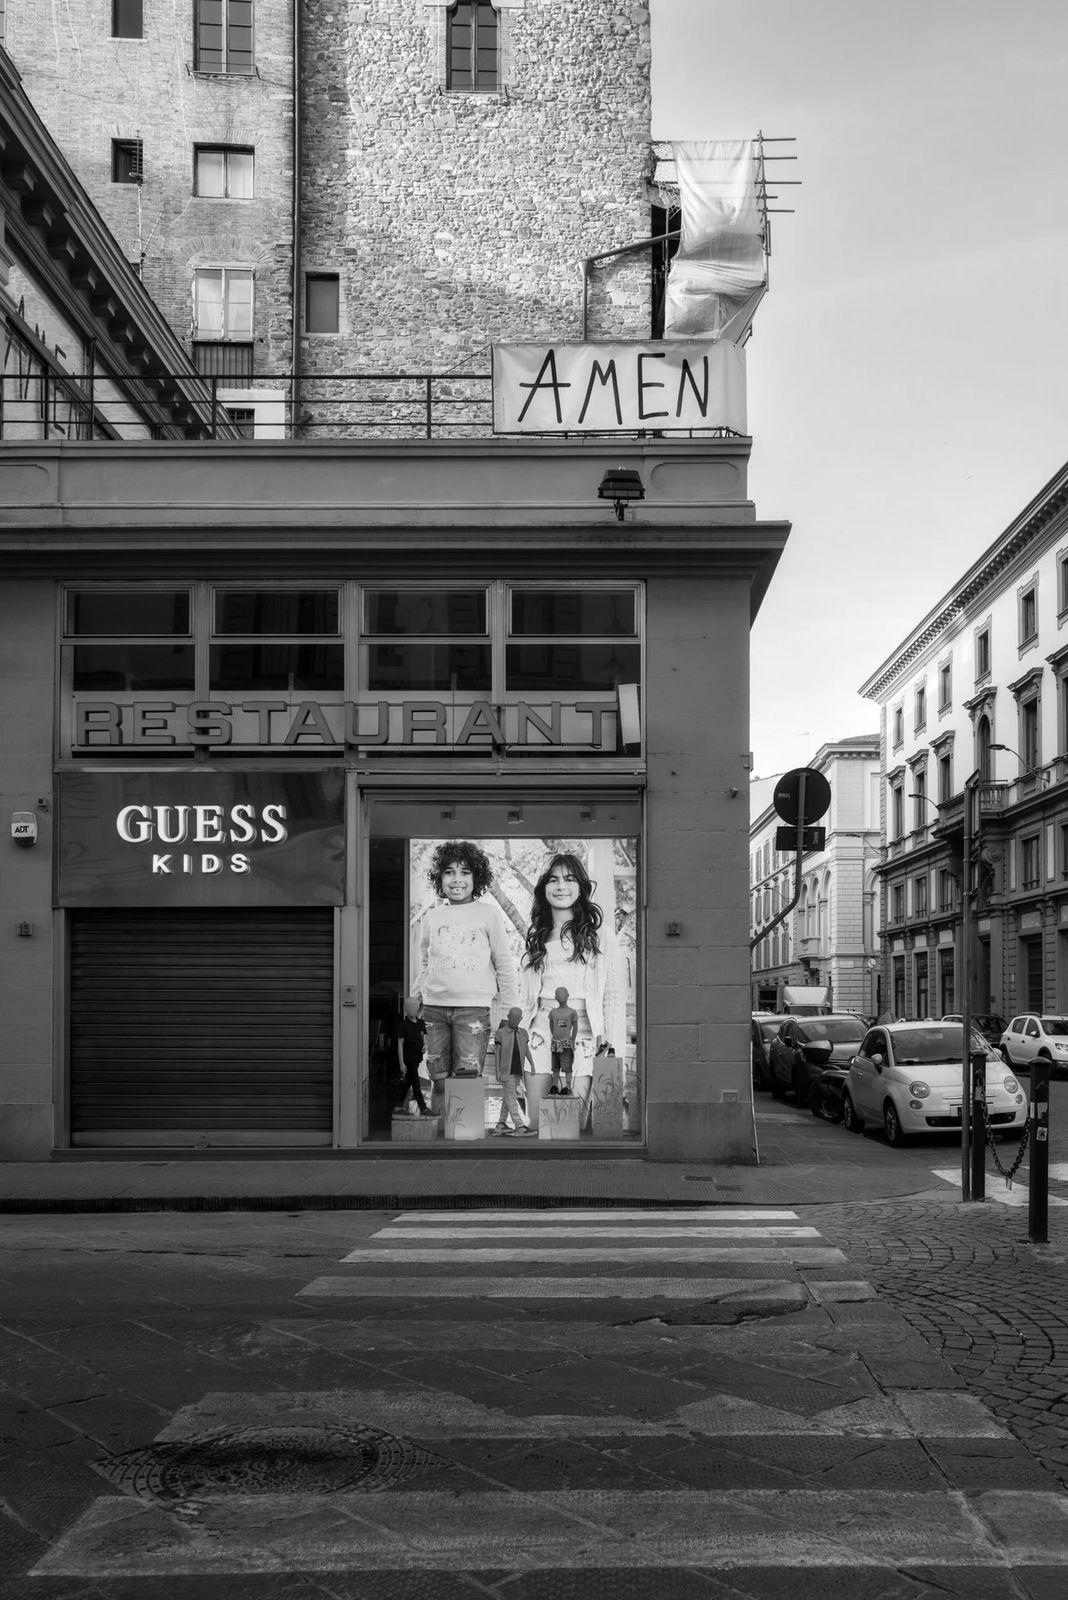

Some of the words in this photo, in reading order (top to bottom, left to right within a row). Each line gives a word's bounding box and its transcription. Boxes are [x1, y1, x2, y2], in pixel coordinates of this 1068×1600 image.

[517, 348, 709, 426] AMEN
[76, 700, 618, 746] RESTAURANT
[14, 825, 30, 834] ADT
[116, 804, 288, 845] GUESS
[152, 853, 252, 875] KIDS
